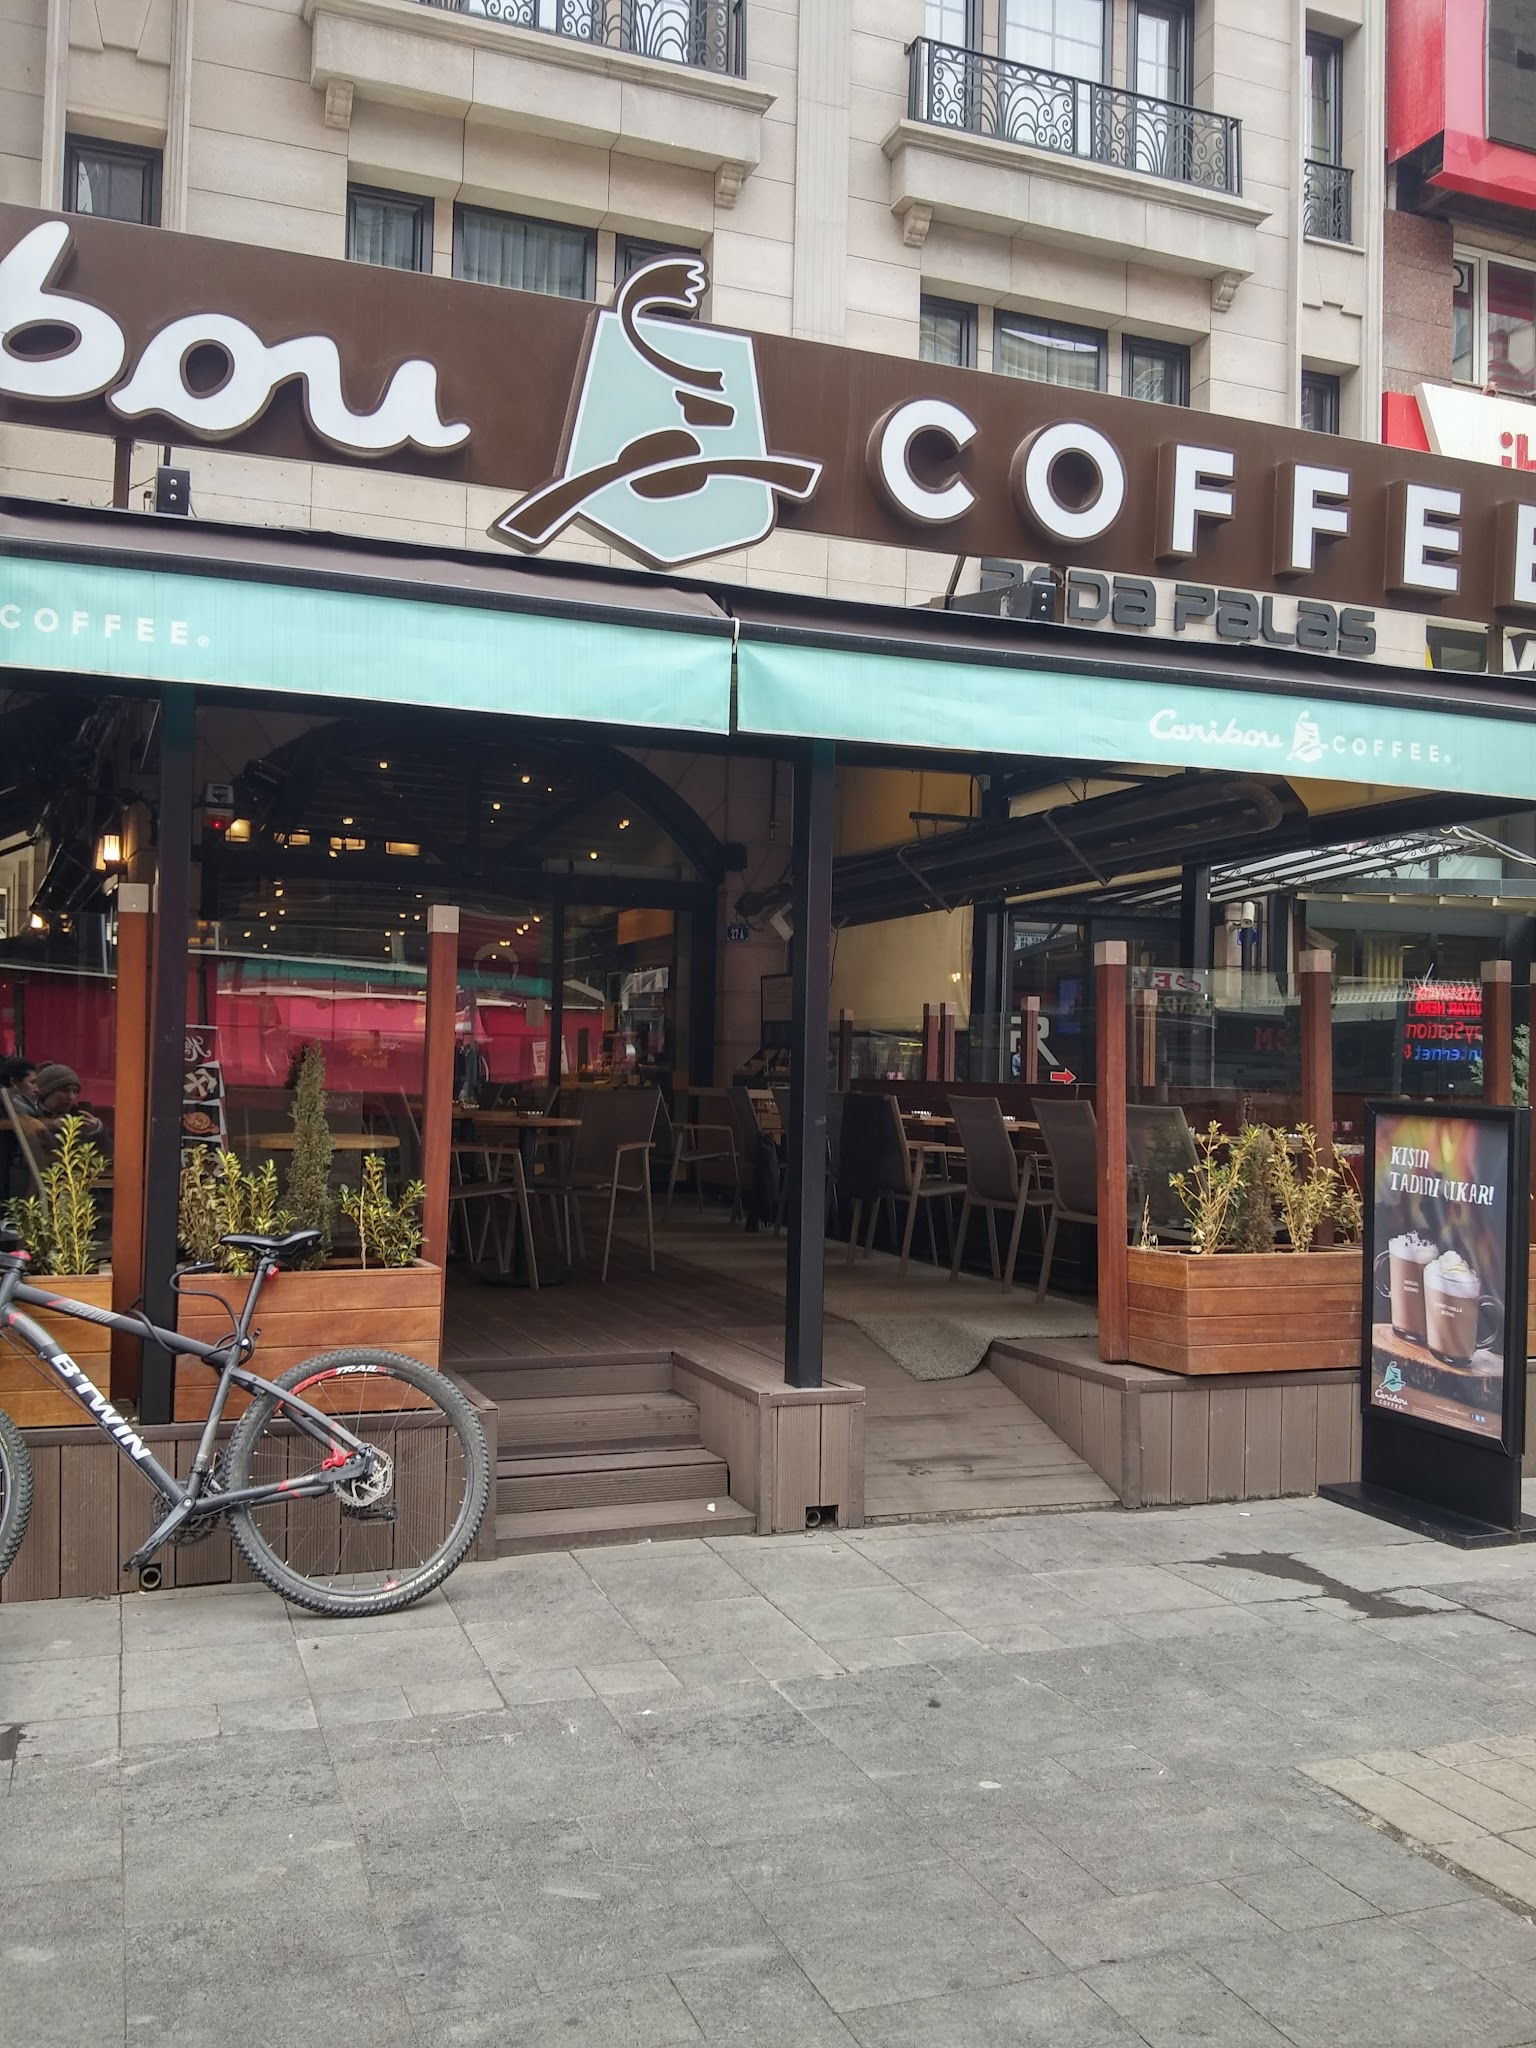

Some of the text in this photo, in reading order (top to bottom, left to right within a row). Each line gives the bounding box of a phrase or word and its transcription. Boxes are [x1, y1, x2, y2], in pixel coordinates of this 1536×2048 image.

[1148, 708, 1284, 748] Caribou
[1389, 1172, 1441, 1198] TADINI
[335, 1365, 378, 1375] TRAIL
[1375, 1388, 1408, 1405] Caribou
